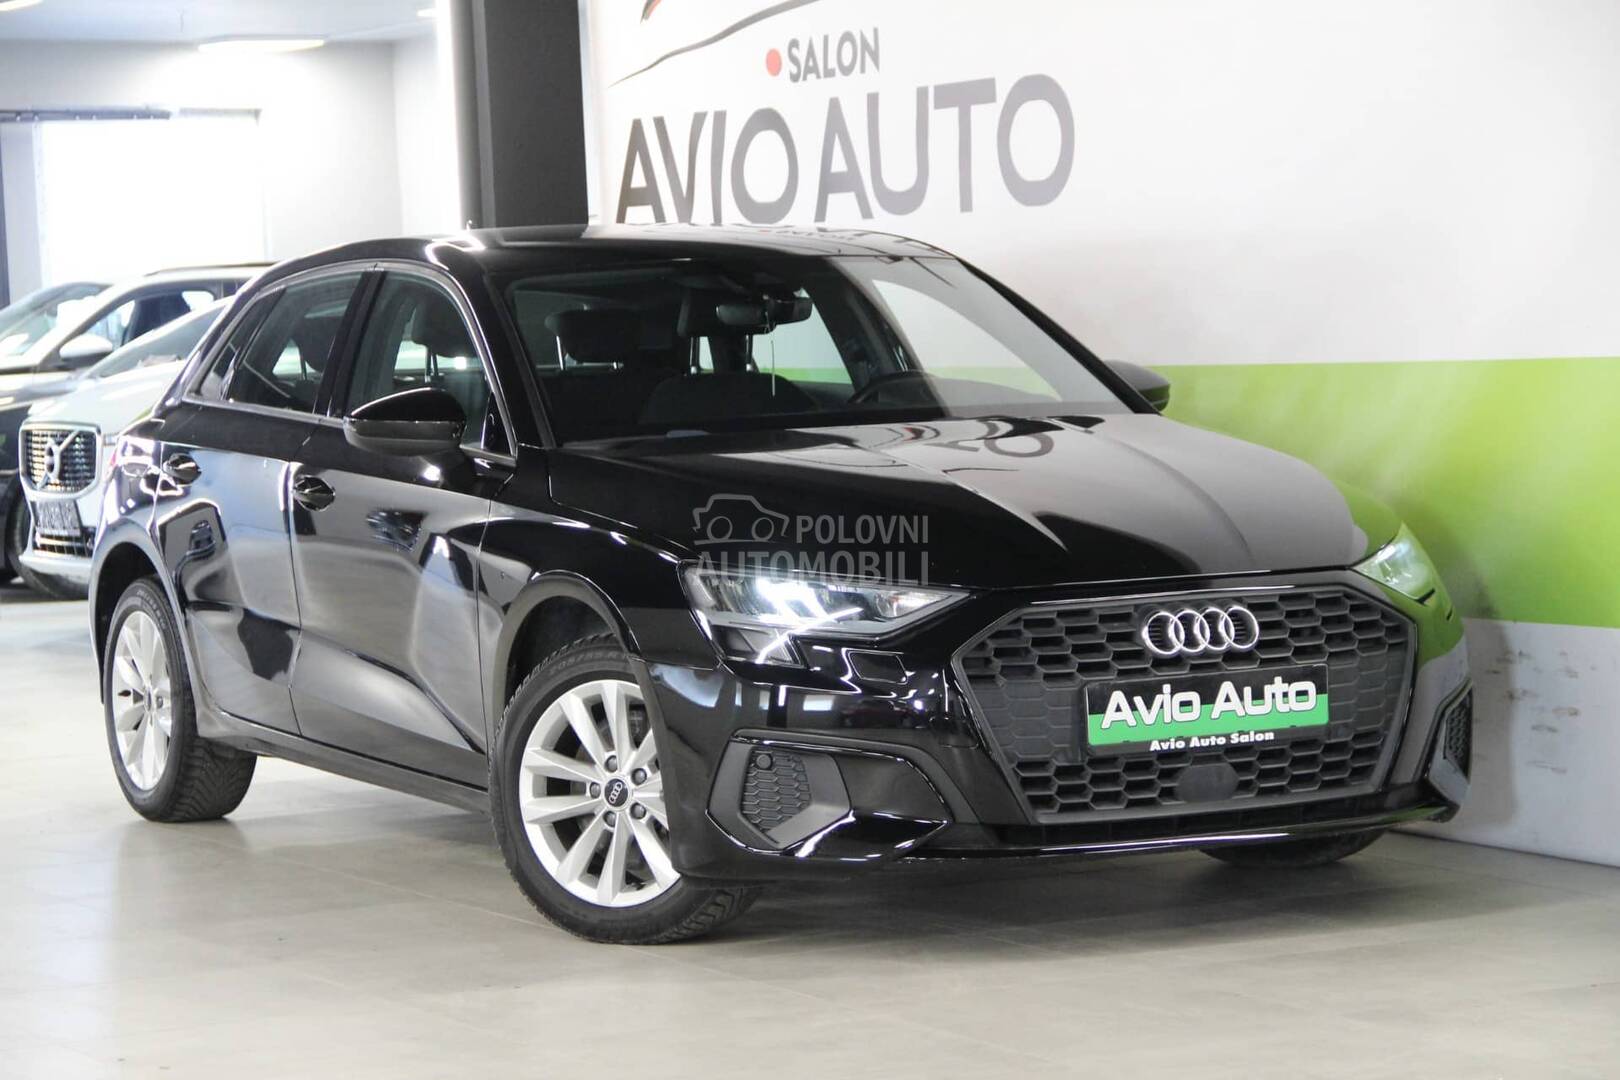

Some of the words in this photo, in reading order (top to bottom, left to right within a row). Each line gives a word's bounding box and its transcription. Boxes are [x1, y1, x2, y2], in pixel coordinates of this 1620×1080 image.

[787, 27, 880, 82] SALON
[615, 107, 799, 224] AVIO
[814, 74, 1075, 222] AUTO
[1101, 683, 1201, 729] Avio
[1211, 676, 1317, 719] Auto
[1150, 738, 1186, 751] Avio
[1189, 736, 1226, 747] Auto
[1230, 731, 1274, 744] Salon
